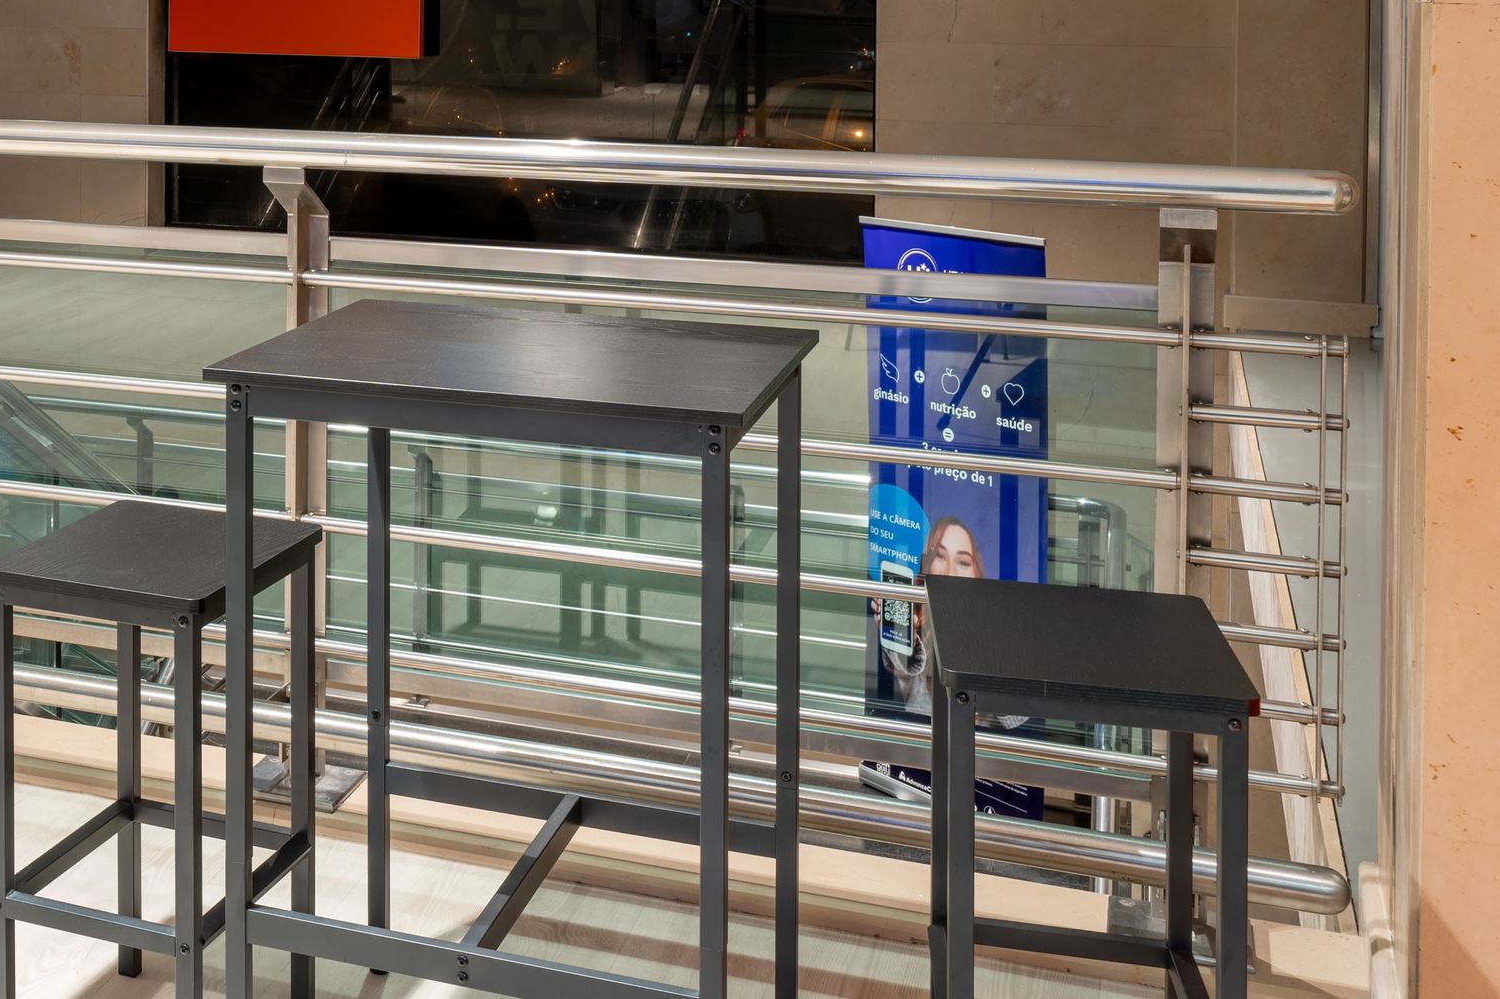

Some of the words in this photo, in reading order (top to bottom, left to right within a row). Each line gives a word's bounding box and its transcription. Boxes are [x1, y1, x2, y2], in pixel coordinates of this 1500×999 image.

[873, 387, 909, 404] ginásio
[930, 400, 977, 420] nutrição
[995, 416, 1033, 432] saúde
[934, 467, 968, 481] preço
[971, 471, 986, 485] de
[987, 475, 994, 487] 1
[870, 509, 882, 520] USE
[882, 513, 888, 522] A
[889, 514, 922, 531] CÂMERA
[870, 525, 879, 536] DO
[880, 529, 894, 540] SEU
[869, 542, 919, 565] SMARTPHONE
